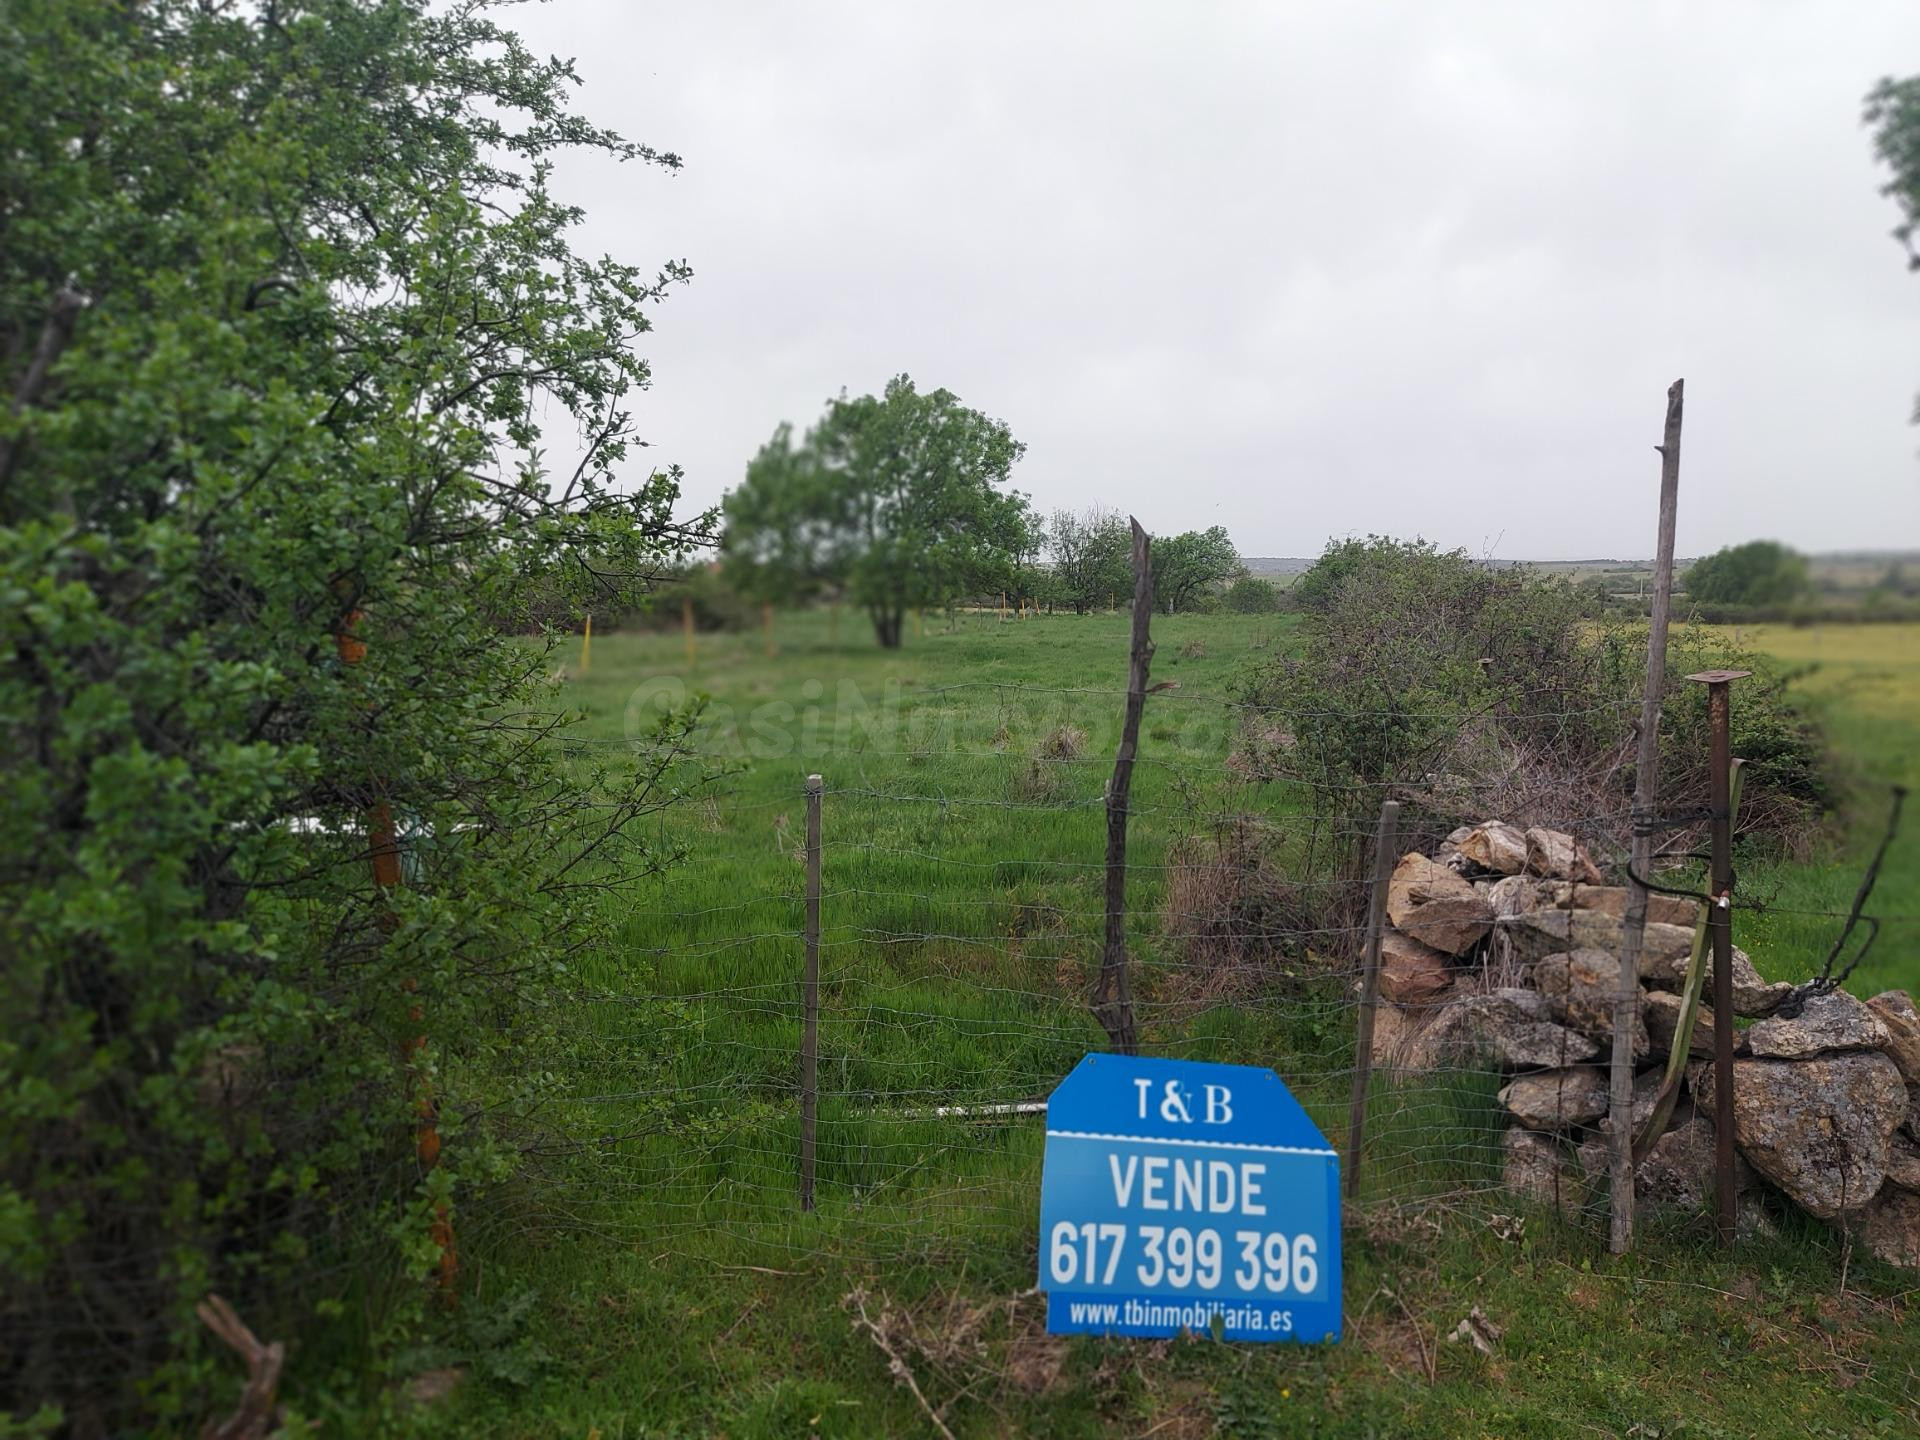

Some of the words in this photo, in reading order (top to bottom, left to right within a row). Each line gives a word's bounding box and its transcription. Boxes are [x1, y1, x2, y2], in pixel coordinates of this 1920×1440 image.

[1134, 1079, 1152, 1119] T
[1160, 1080, 1194, 1124] &
[1204, 1085, 1233, 1124] B
[1109, 1154, 1267, 1216] VENDE
[1051, 1221, 1127, 1285] 617
[1137, 1226, 1223, 1290] 399
[1235, 1231, 1319, 1294] 396
